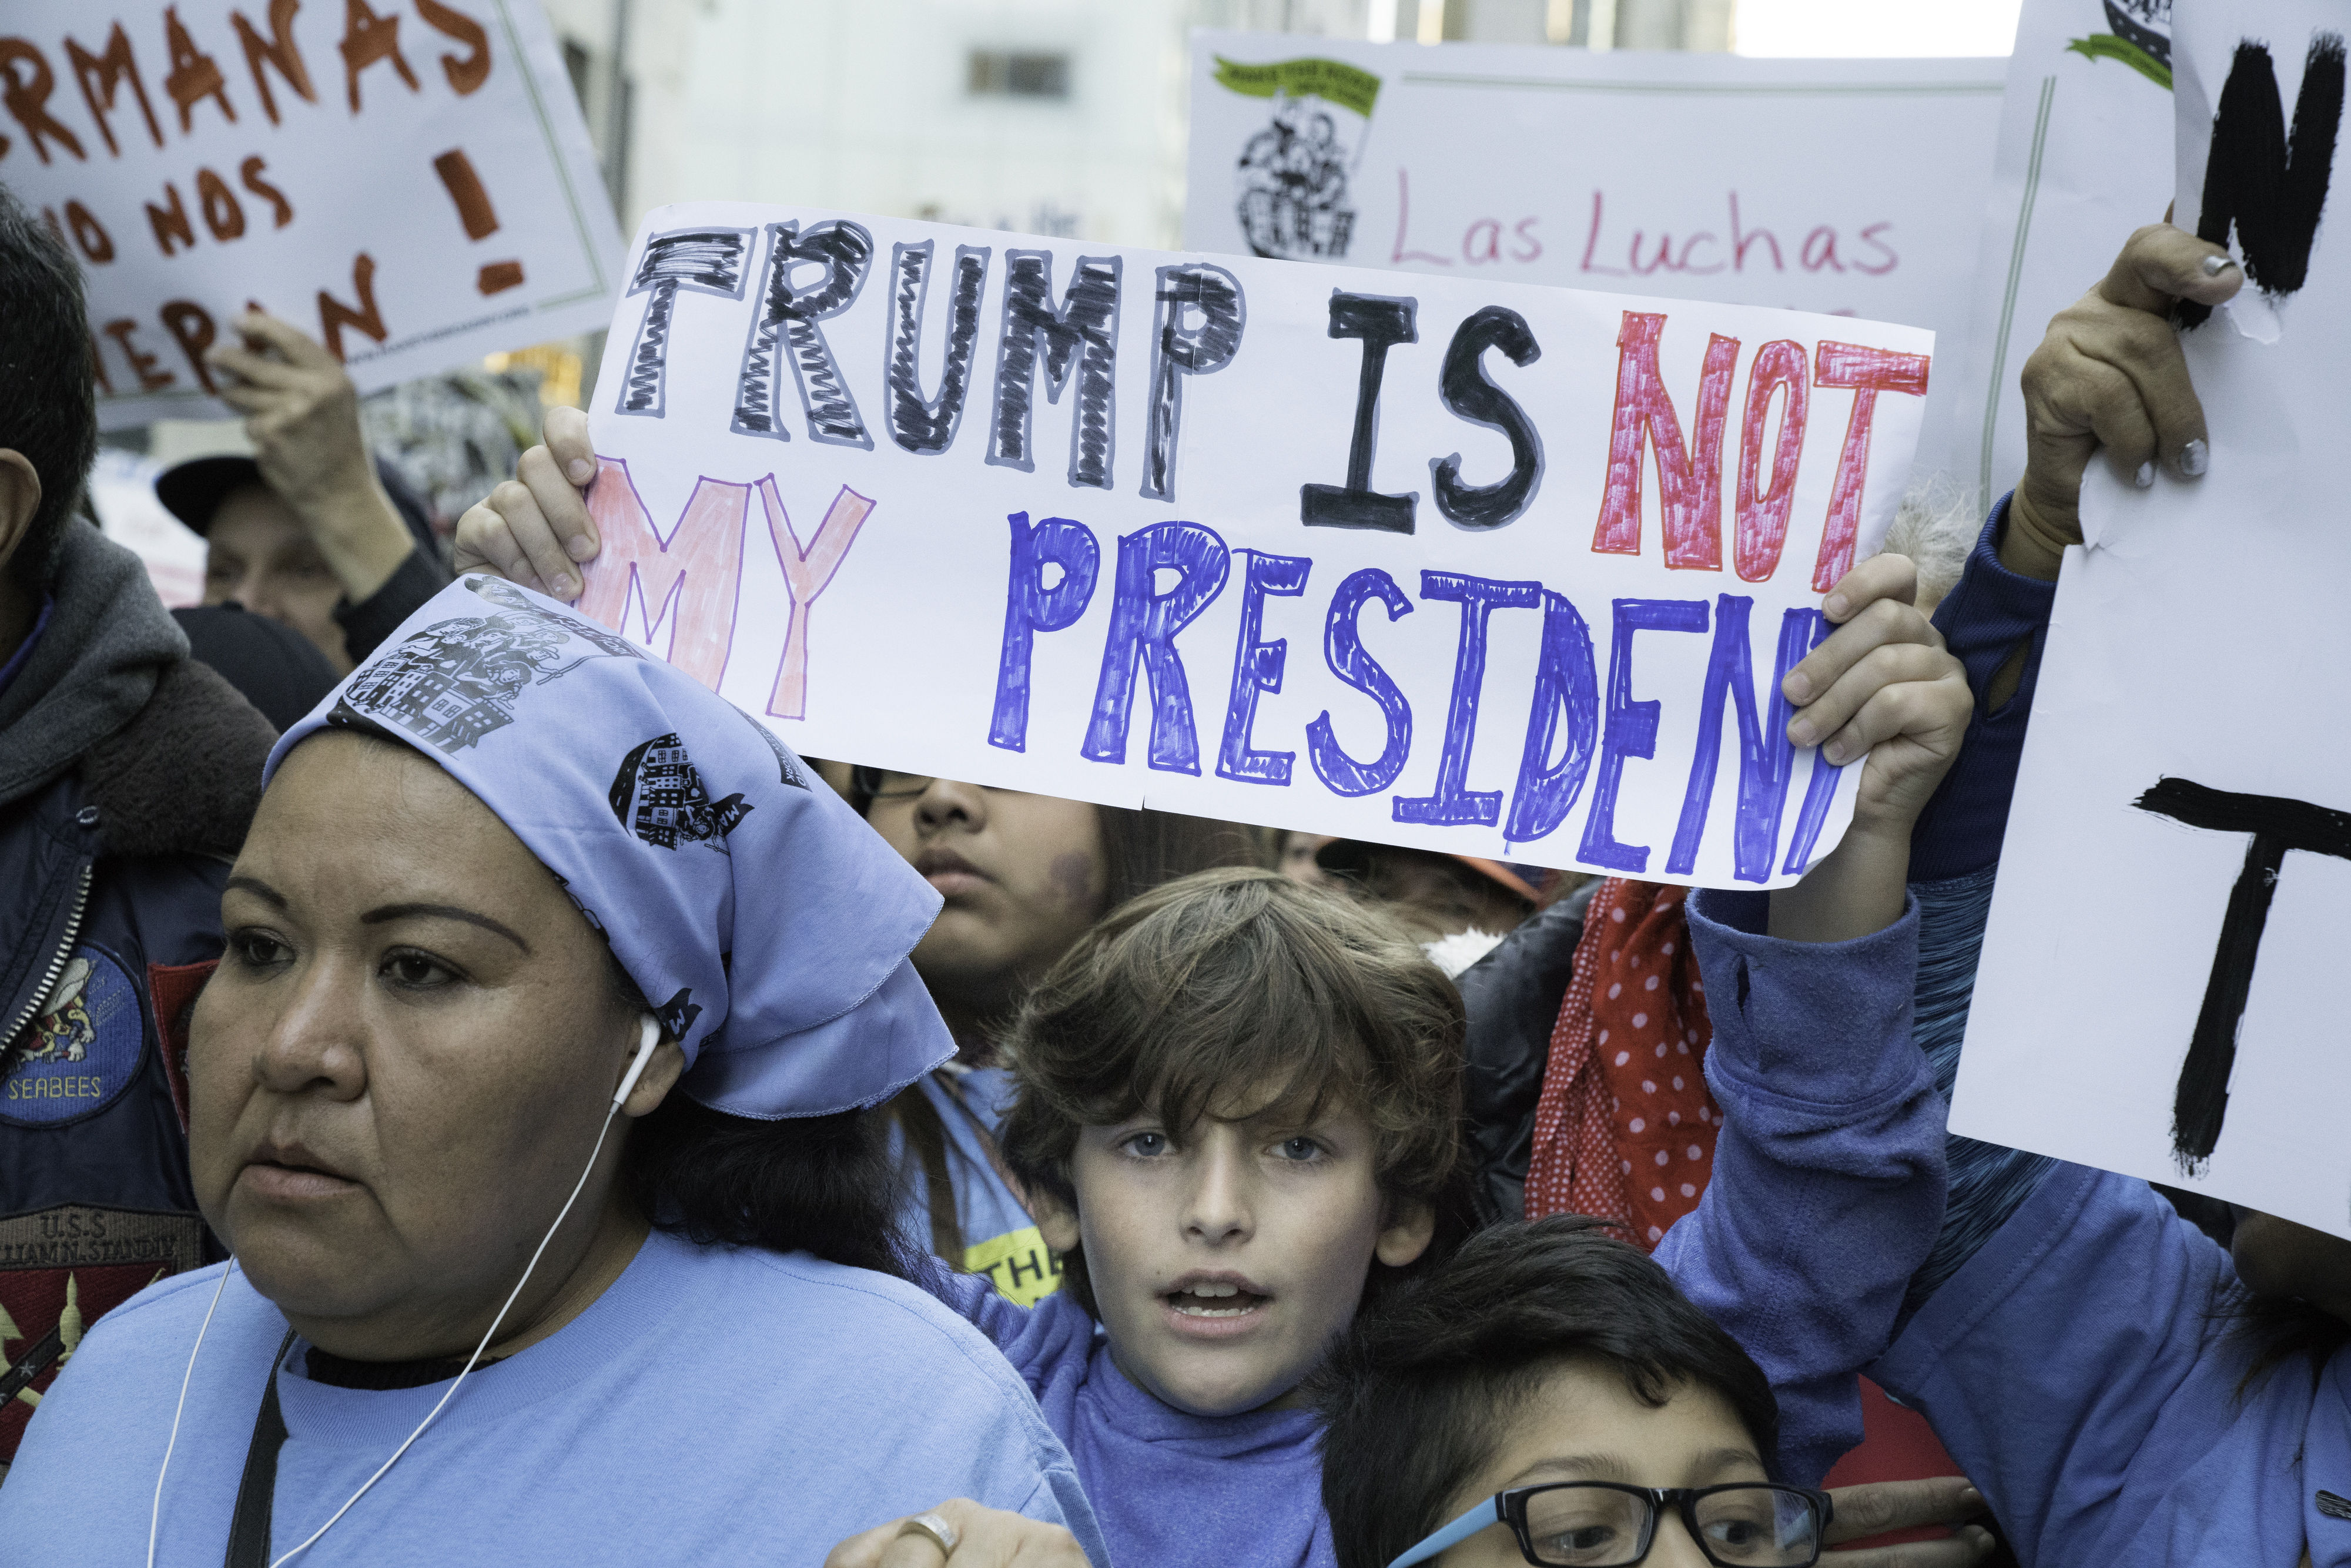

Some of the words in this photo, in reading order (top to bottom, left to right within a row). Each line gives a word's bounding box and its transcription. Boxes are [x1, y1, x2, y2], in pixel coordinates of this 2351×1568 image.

[0, 0, 493, 163] RMANAS
[145, 155, 293, 257] NOS
[1391, 166, 1545, 267] Las
[1581, 189, 1900, 278] Luchas
[615, 220, 1247, 502] TRUMP
[1300, 287, 1545, 535] IS
[1592, 310, 1931, 594] NOT
[570, 454, 877, 721] MY
[718, 803, 740, 827] MA
[8, 1077, 101, 1100] SEABEES
